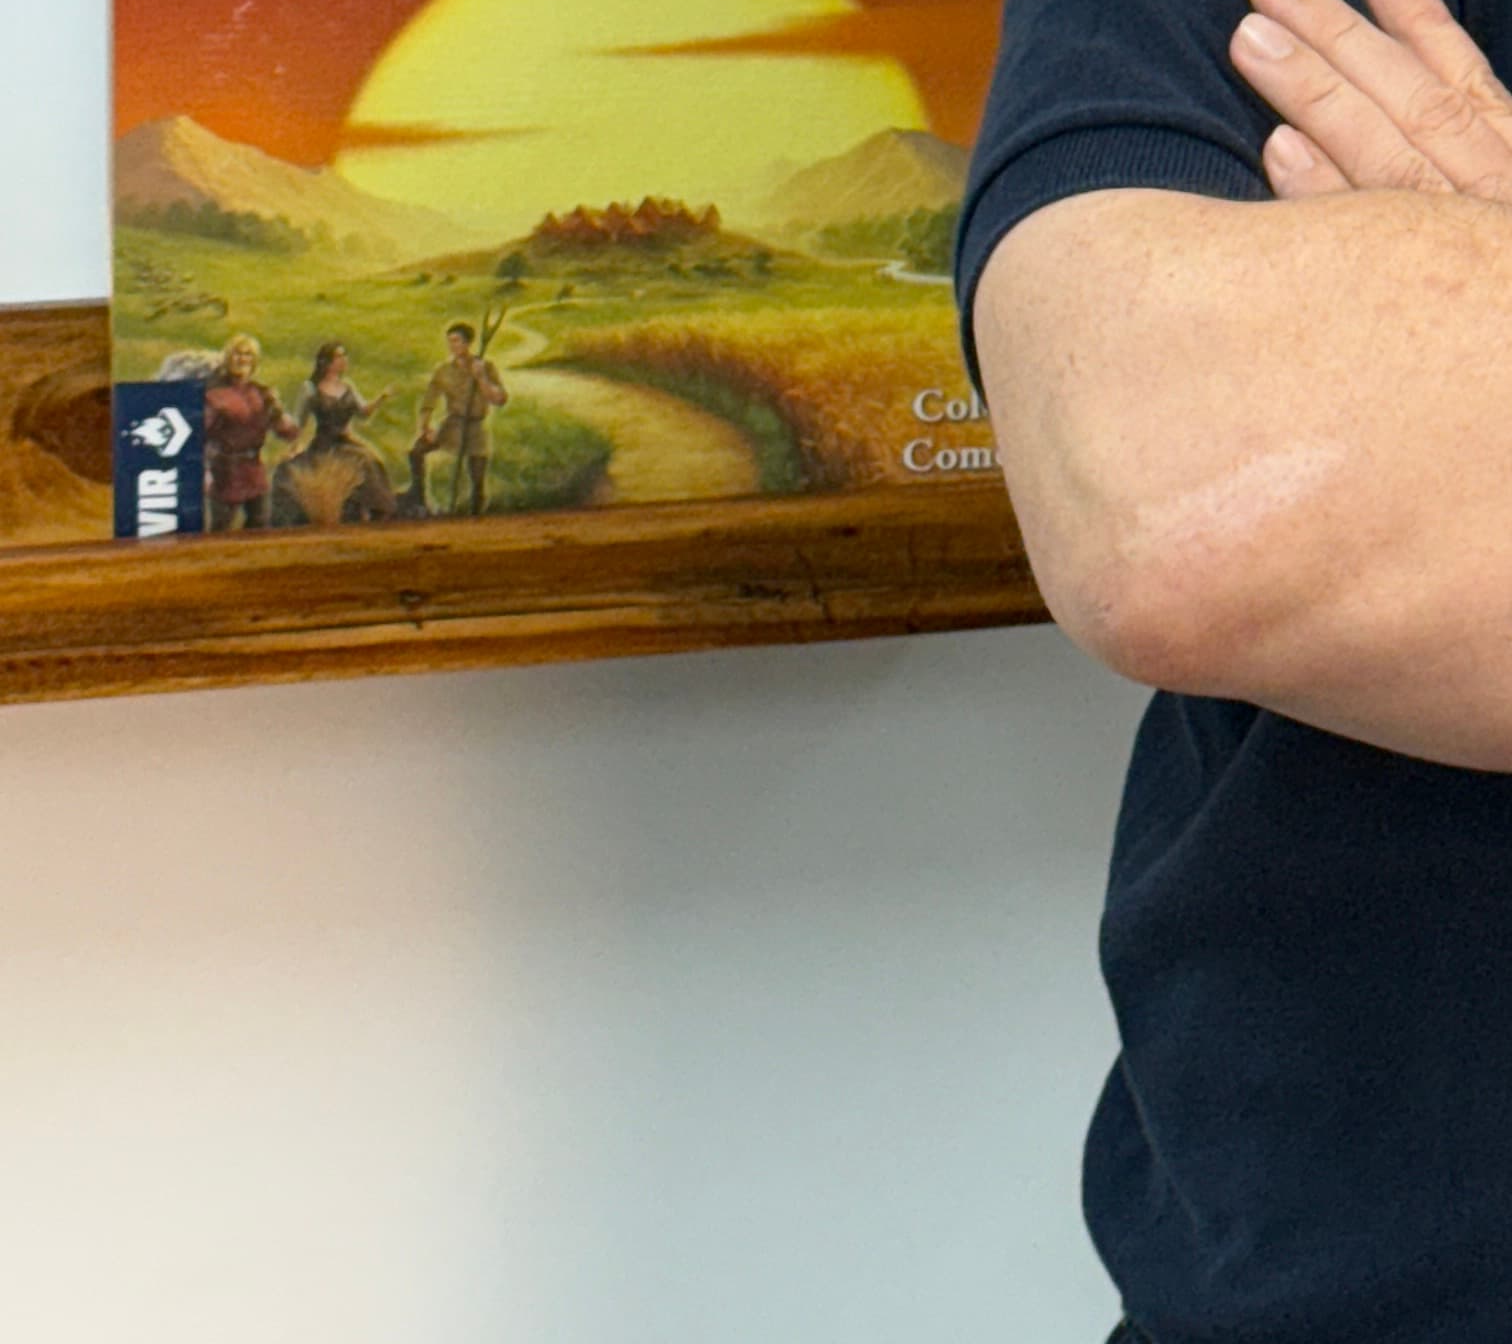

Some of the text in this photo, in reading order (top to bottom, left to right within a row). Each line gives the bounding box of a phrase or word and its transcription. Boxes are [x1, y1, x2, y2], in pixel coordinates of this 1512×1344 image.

[911, 387, 989, 423] Col
[902, 436, 1001, 473] Com
[137, 466, 179, 539] VIR
